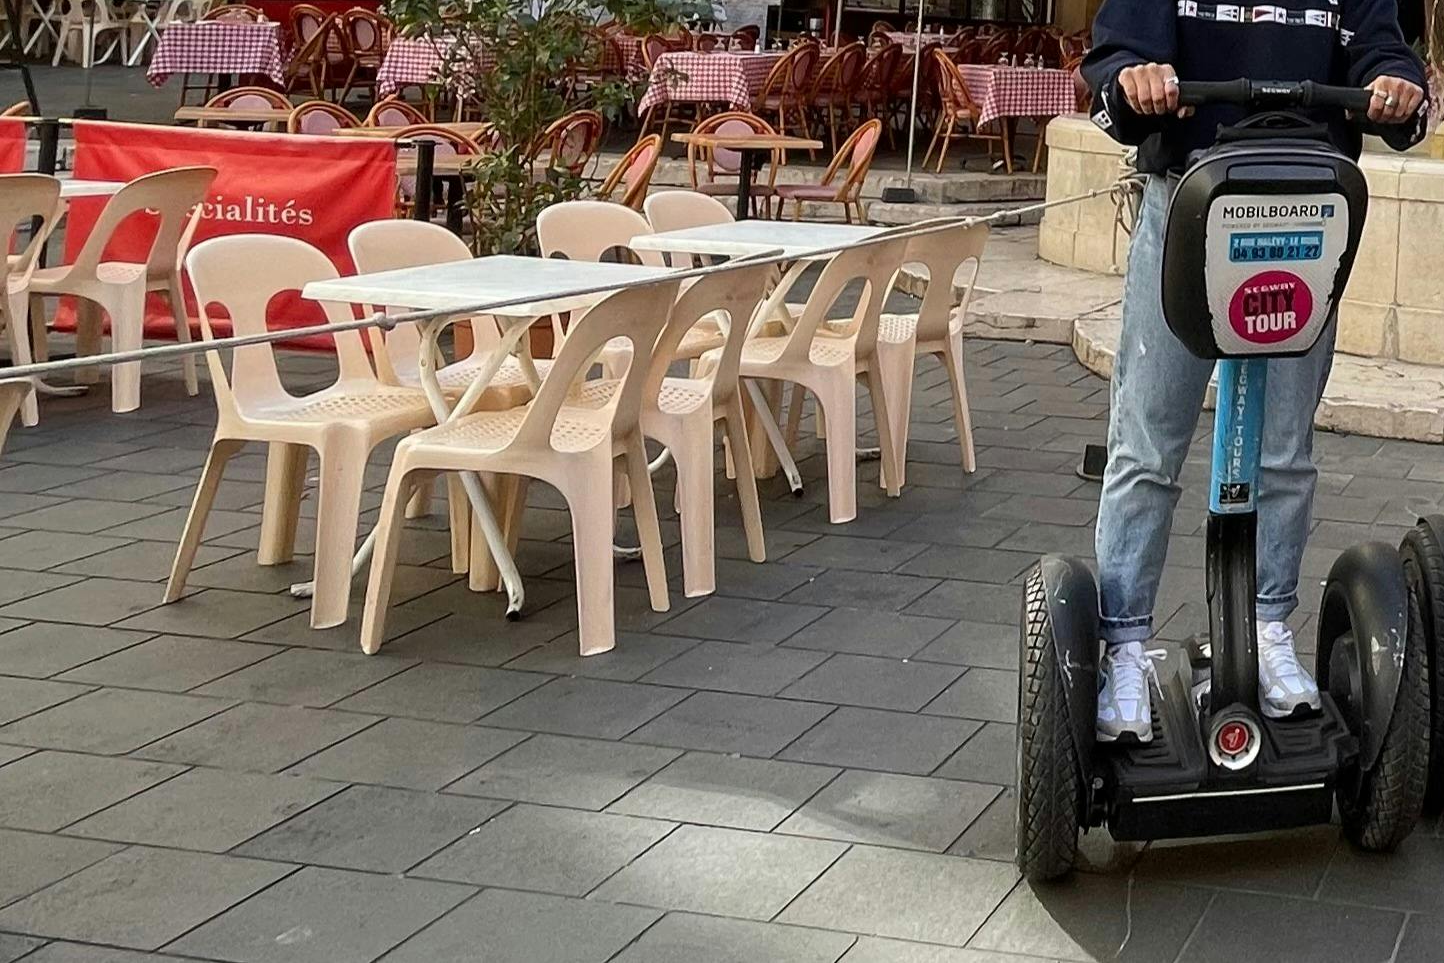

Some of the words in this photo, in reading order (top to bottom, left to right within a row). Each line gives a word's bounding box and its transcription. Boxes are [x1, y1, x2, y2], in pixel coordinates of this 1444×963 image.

[1223, 205, 1319, 219] MOBILBOARD
[1288, 246, 1299, 258] 21
[1304, 245, 1320, 258] 27
[1244, 282, 1296, 294] SEGWAY
[1243, 290, 1295, 316] CITY
[1244, 311, 1297, 334] TOUR
[1232, 425, 1244, 479] TOURS
